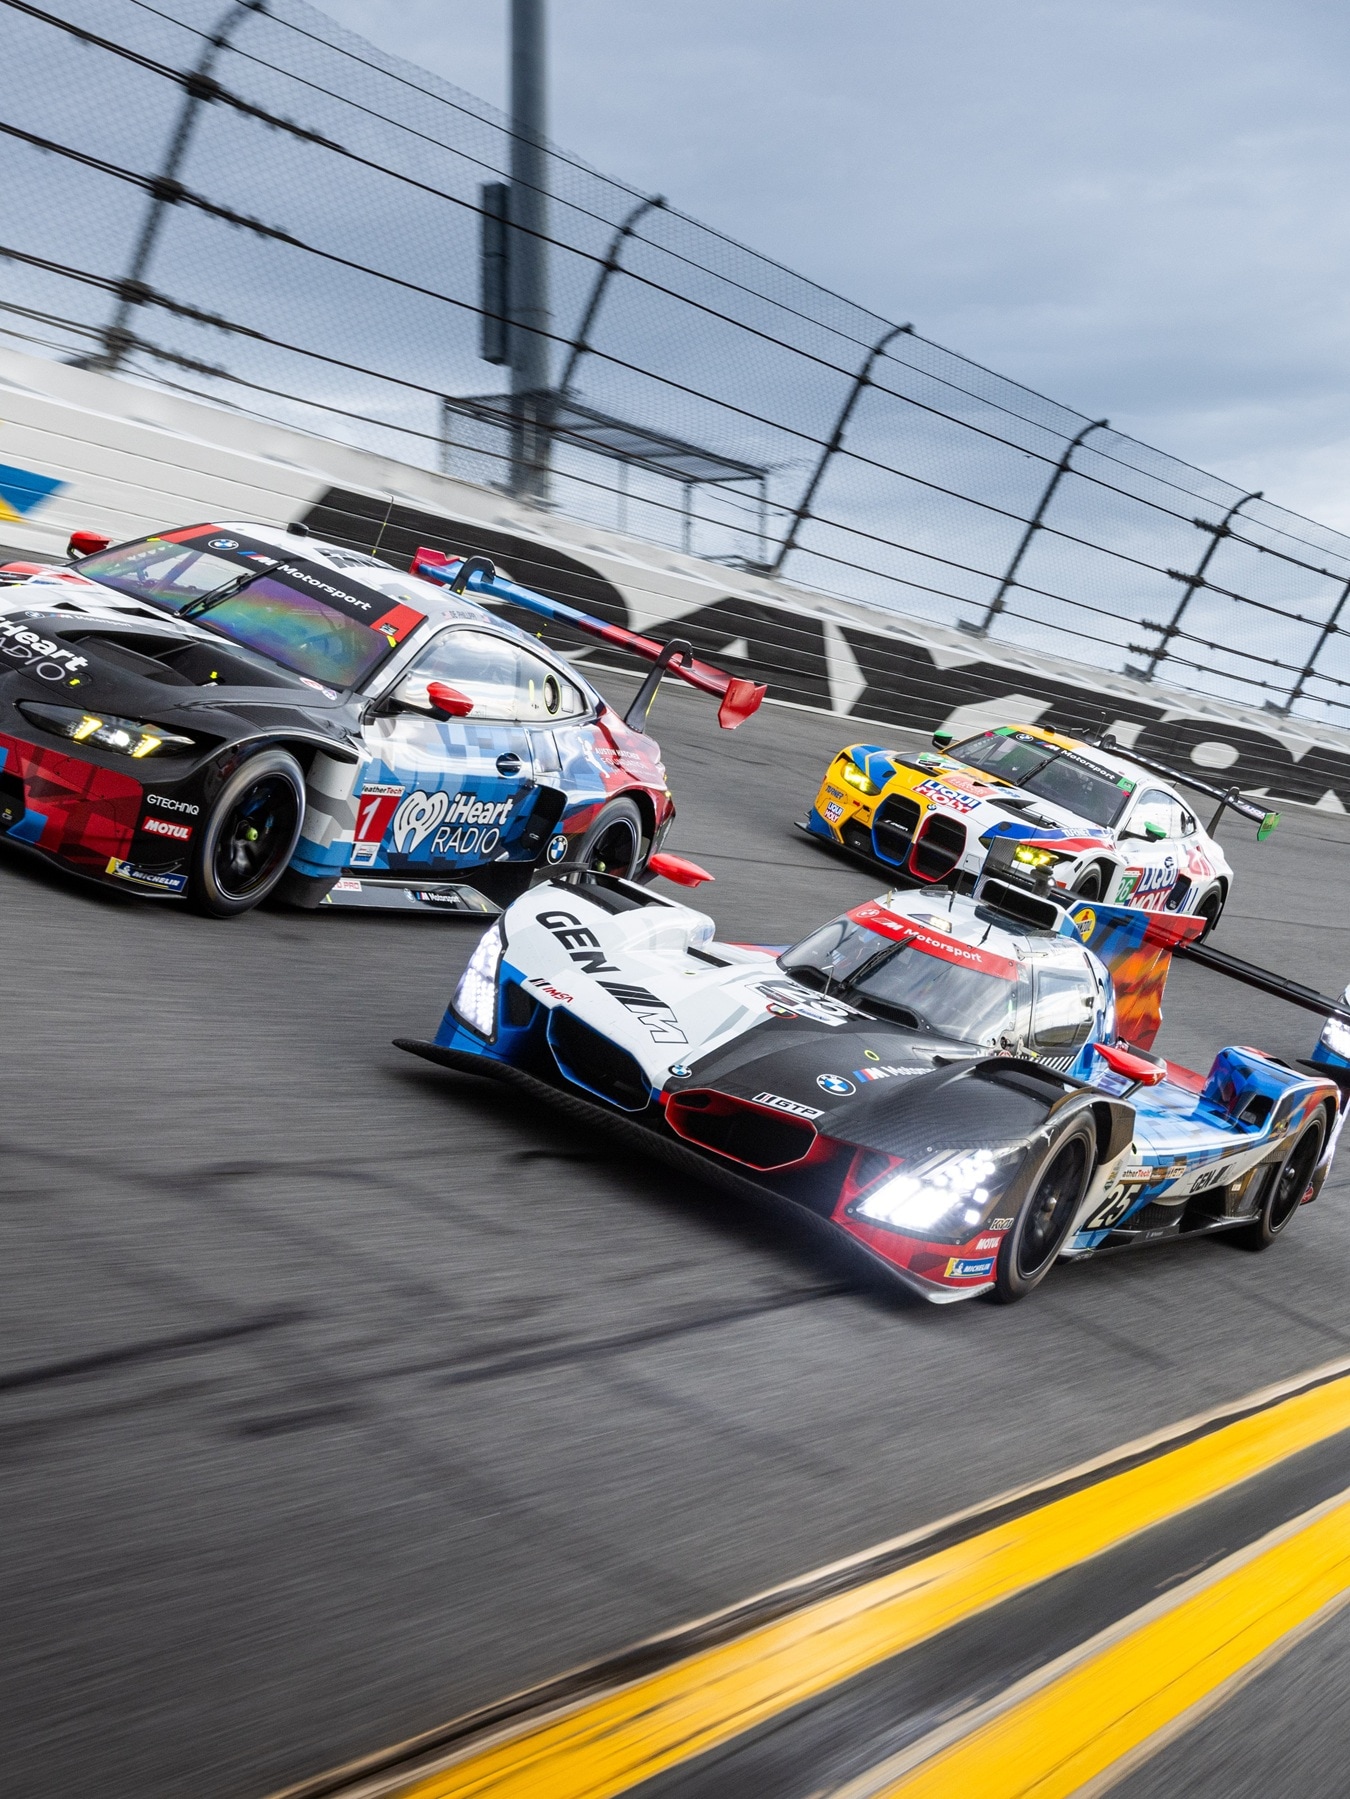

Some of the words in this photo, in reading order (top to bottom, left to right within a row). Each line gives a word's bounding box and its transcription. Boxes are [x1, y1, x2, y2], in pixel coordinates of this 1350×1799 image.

[278, 564, 372, 611] Motorsport
[1061, 749, 1116, 780] Motorsport
[914, 786, 972, 812] MOLY
[922, 779, 981, 808] LIQUI
[358, 797, 382, 839] 1
[445, 794, 514, 825] iHeart
[824, 810, 840, 822] MOLY
[828, 802, 843, 814] LIQUI
[144, 819, 189, 839] MOTUL
[430, 827, 500, 853] RADIO
[132, 871, 181, 886] MICHELIN
[535, 911, 622, 974] GEN
[903, 928, 983, 962] Motorsport
[775, 1101, 818, 1115] GTP
[1122, 1168, 1151, 1178] atherTech
[1087, 1184, 1142, 1228] 25
